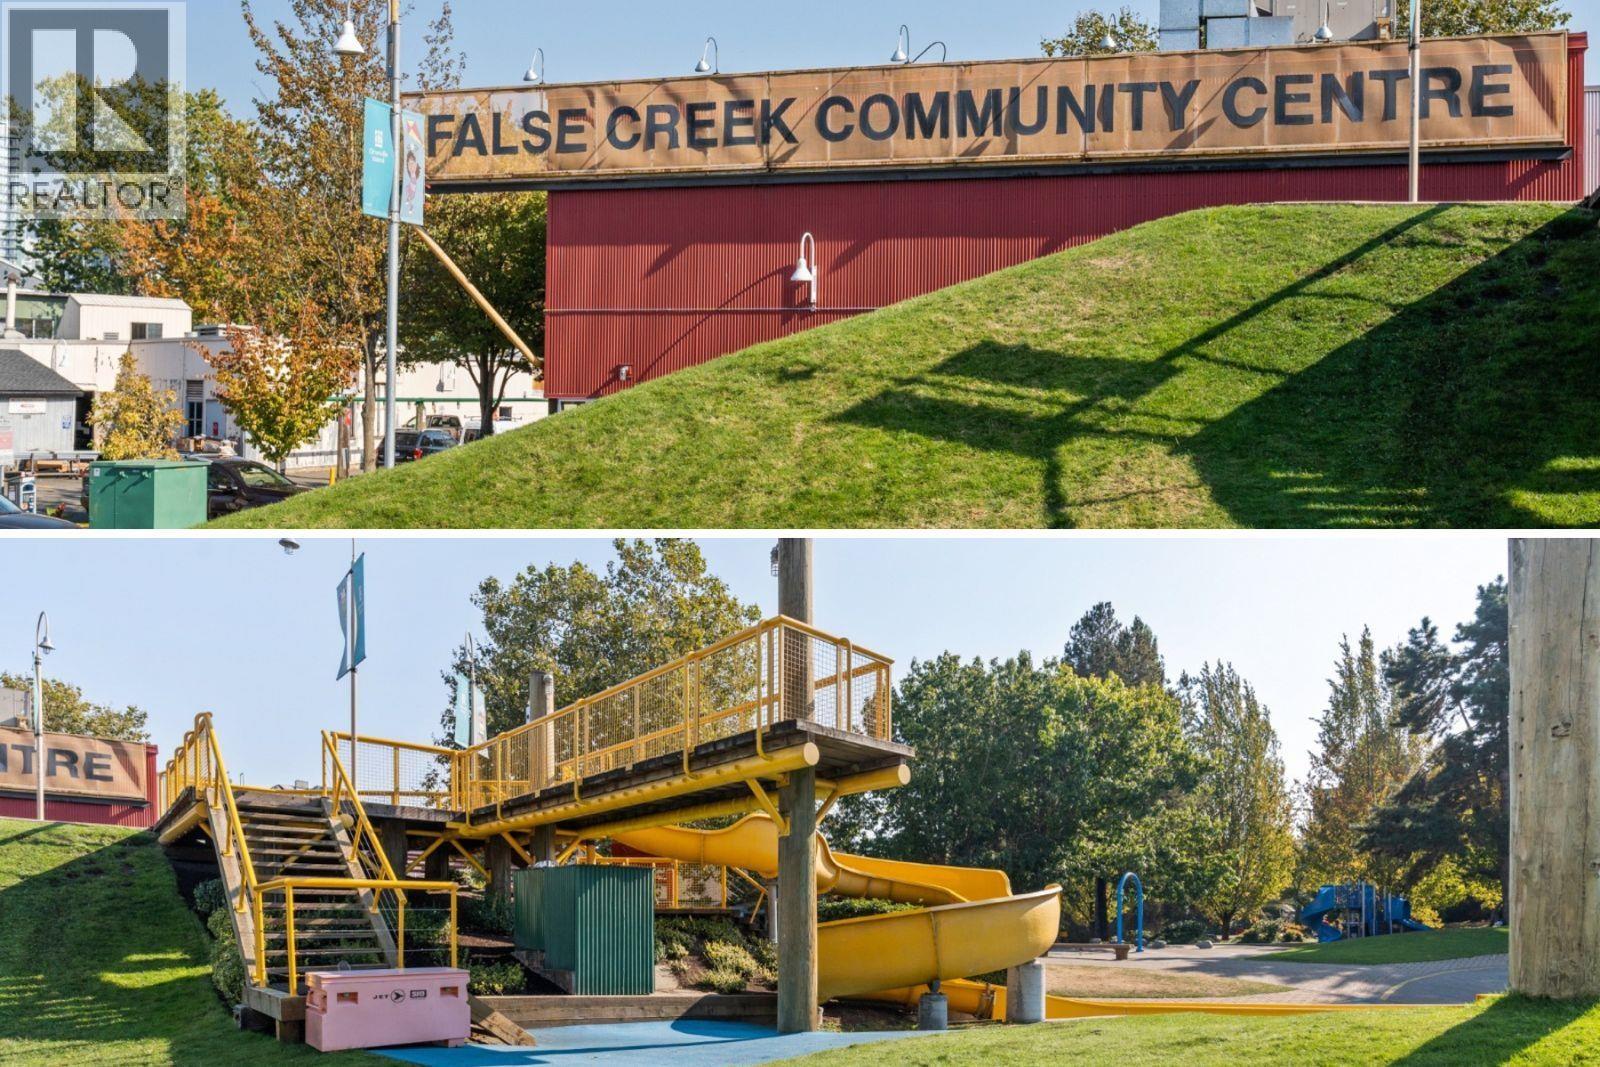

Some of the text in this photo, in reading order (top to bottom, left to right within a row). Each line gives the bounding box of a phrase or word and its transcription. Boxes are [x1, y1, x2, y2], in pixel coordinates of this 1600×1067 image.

[426, 64, 1514, 158] FALSE CREEK COMMUNITY CENTRE
